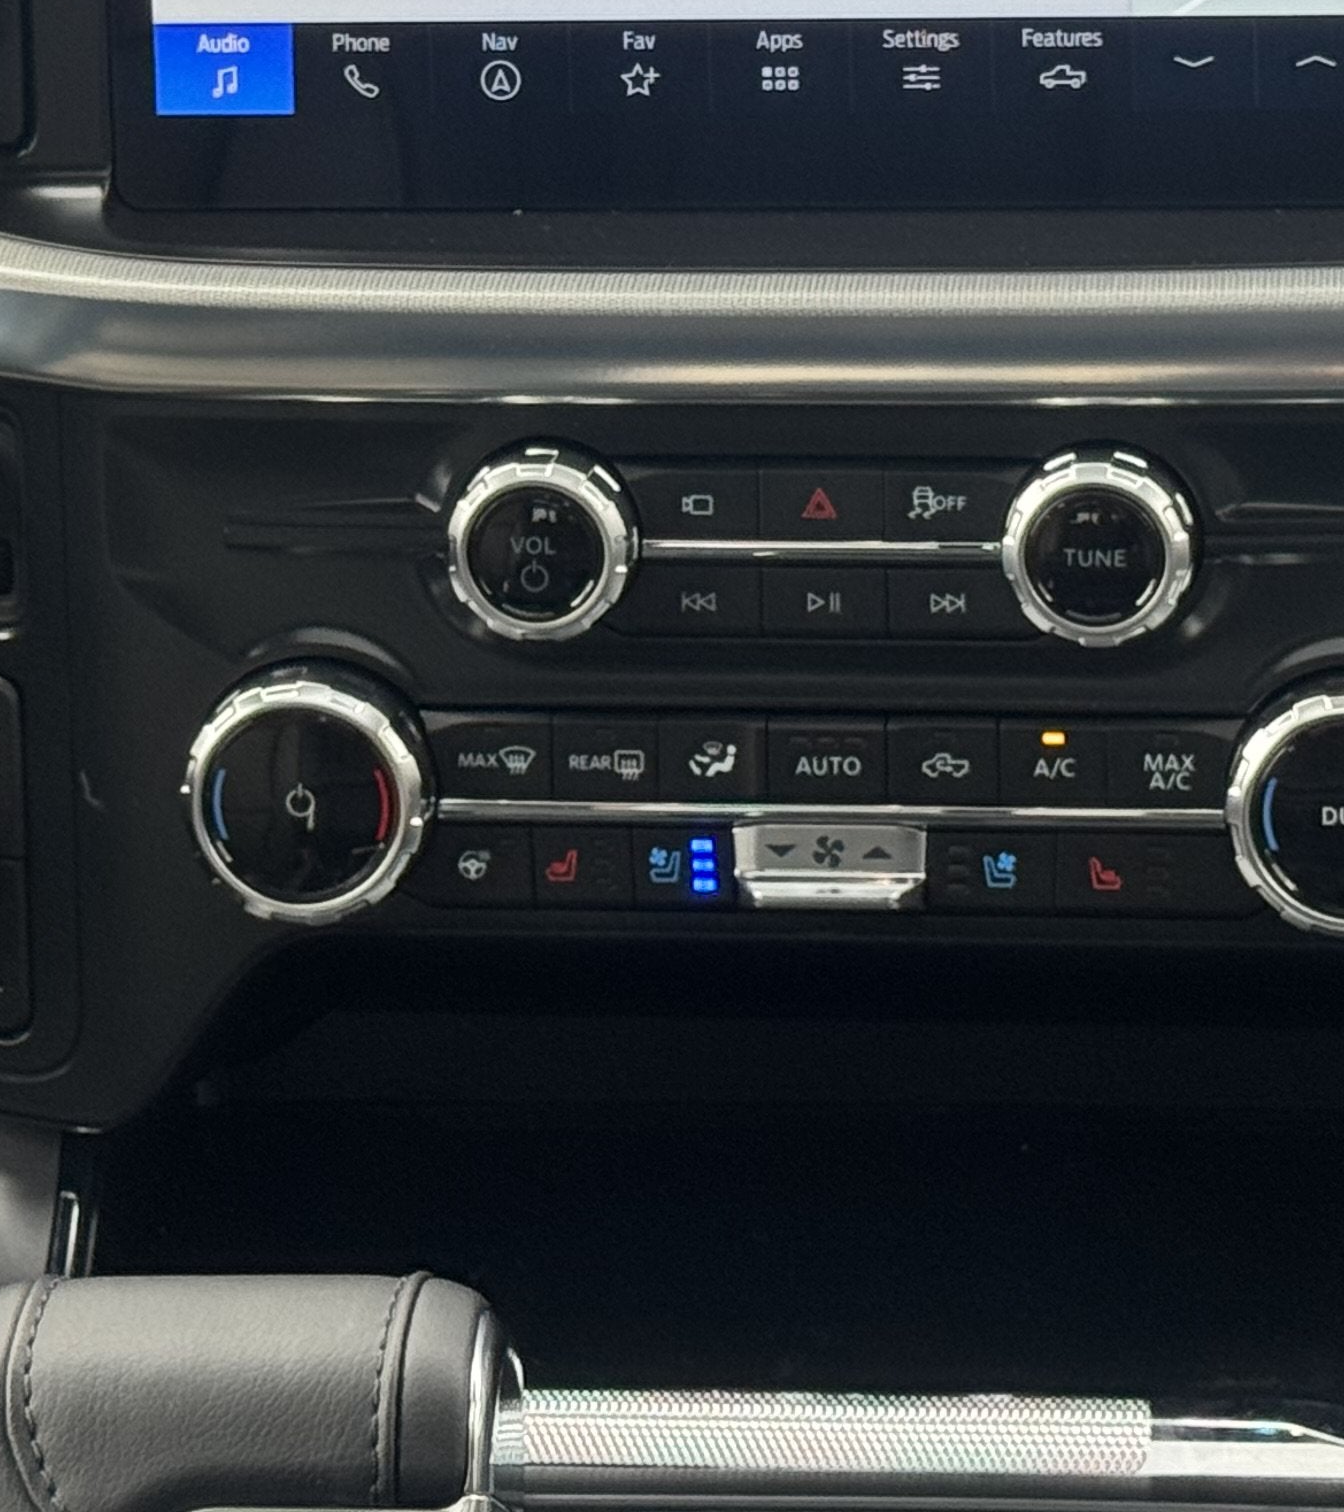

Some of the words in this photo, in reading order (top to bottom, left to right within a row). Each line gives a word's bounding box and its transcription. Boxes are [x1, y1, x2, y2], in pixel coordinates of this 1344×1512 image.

[197, 33, 250, 54] Audio
[332, 32, 391, 53] Phone
[481, 32, 518, 52] Nav
[622, 31, 656, 51] Fav
[755, 30, 804, 55] Apps
[881, 28, 960, 52] Settings
[1021, 28, 1104, 49] Features
[933, 494, 968, 512] OFF
[510, 536, 556, 555] VOL
[1063, 548, 1127, 568] TUNE
[457, 752, 498, 769] MAX
[568, 755, 612, 772] REAR
[795, 755, 862, 778] AUTO
[1033, 756, 1076, 780] A/C
[1143, 752, 1196, 773] MAX
[1149, 769, 1192, 792] A/C
